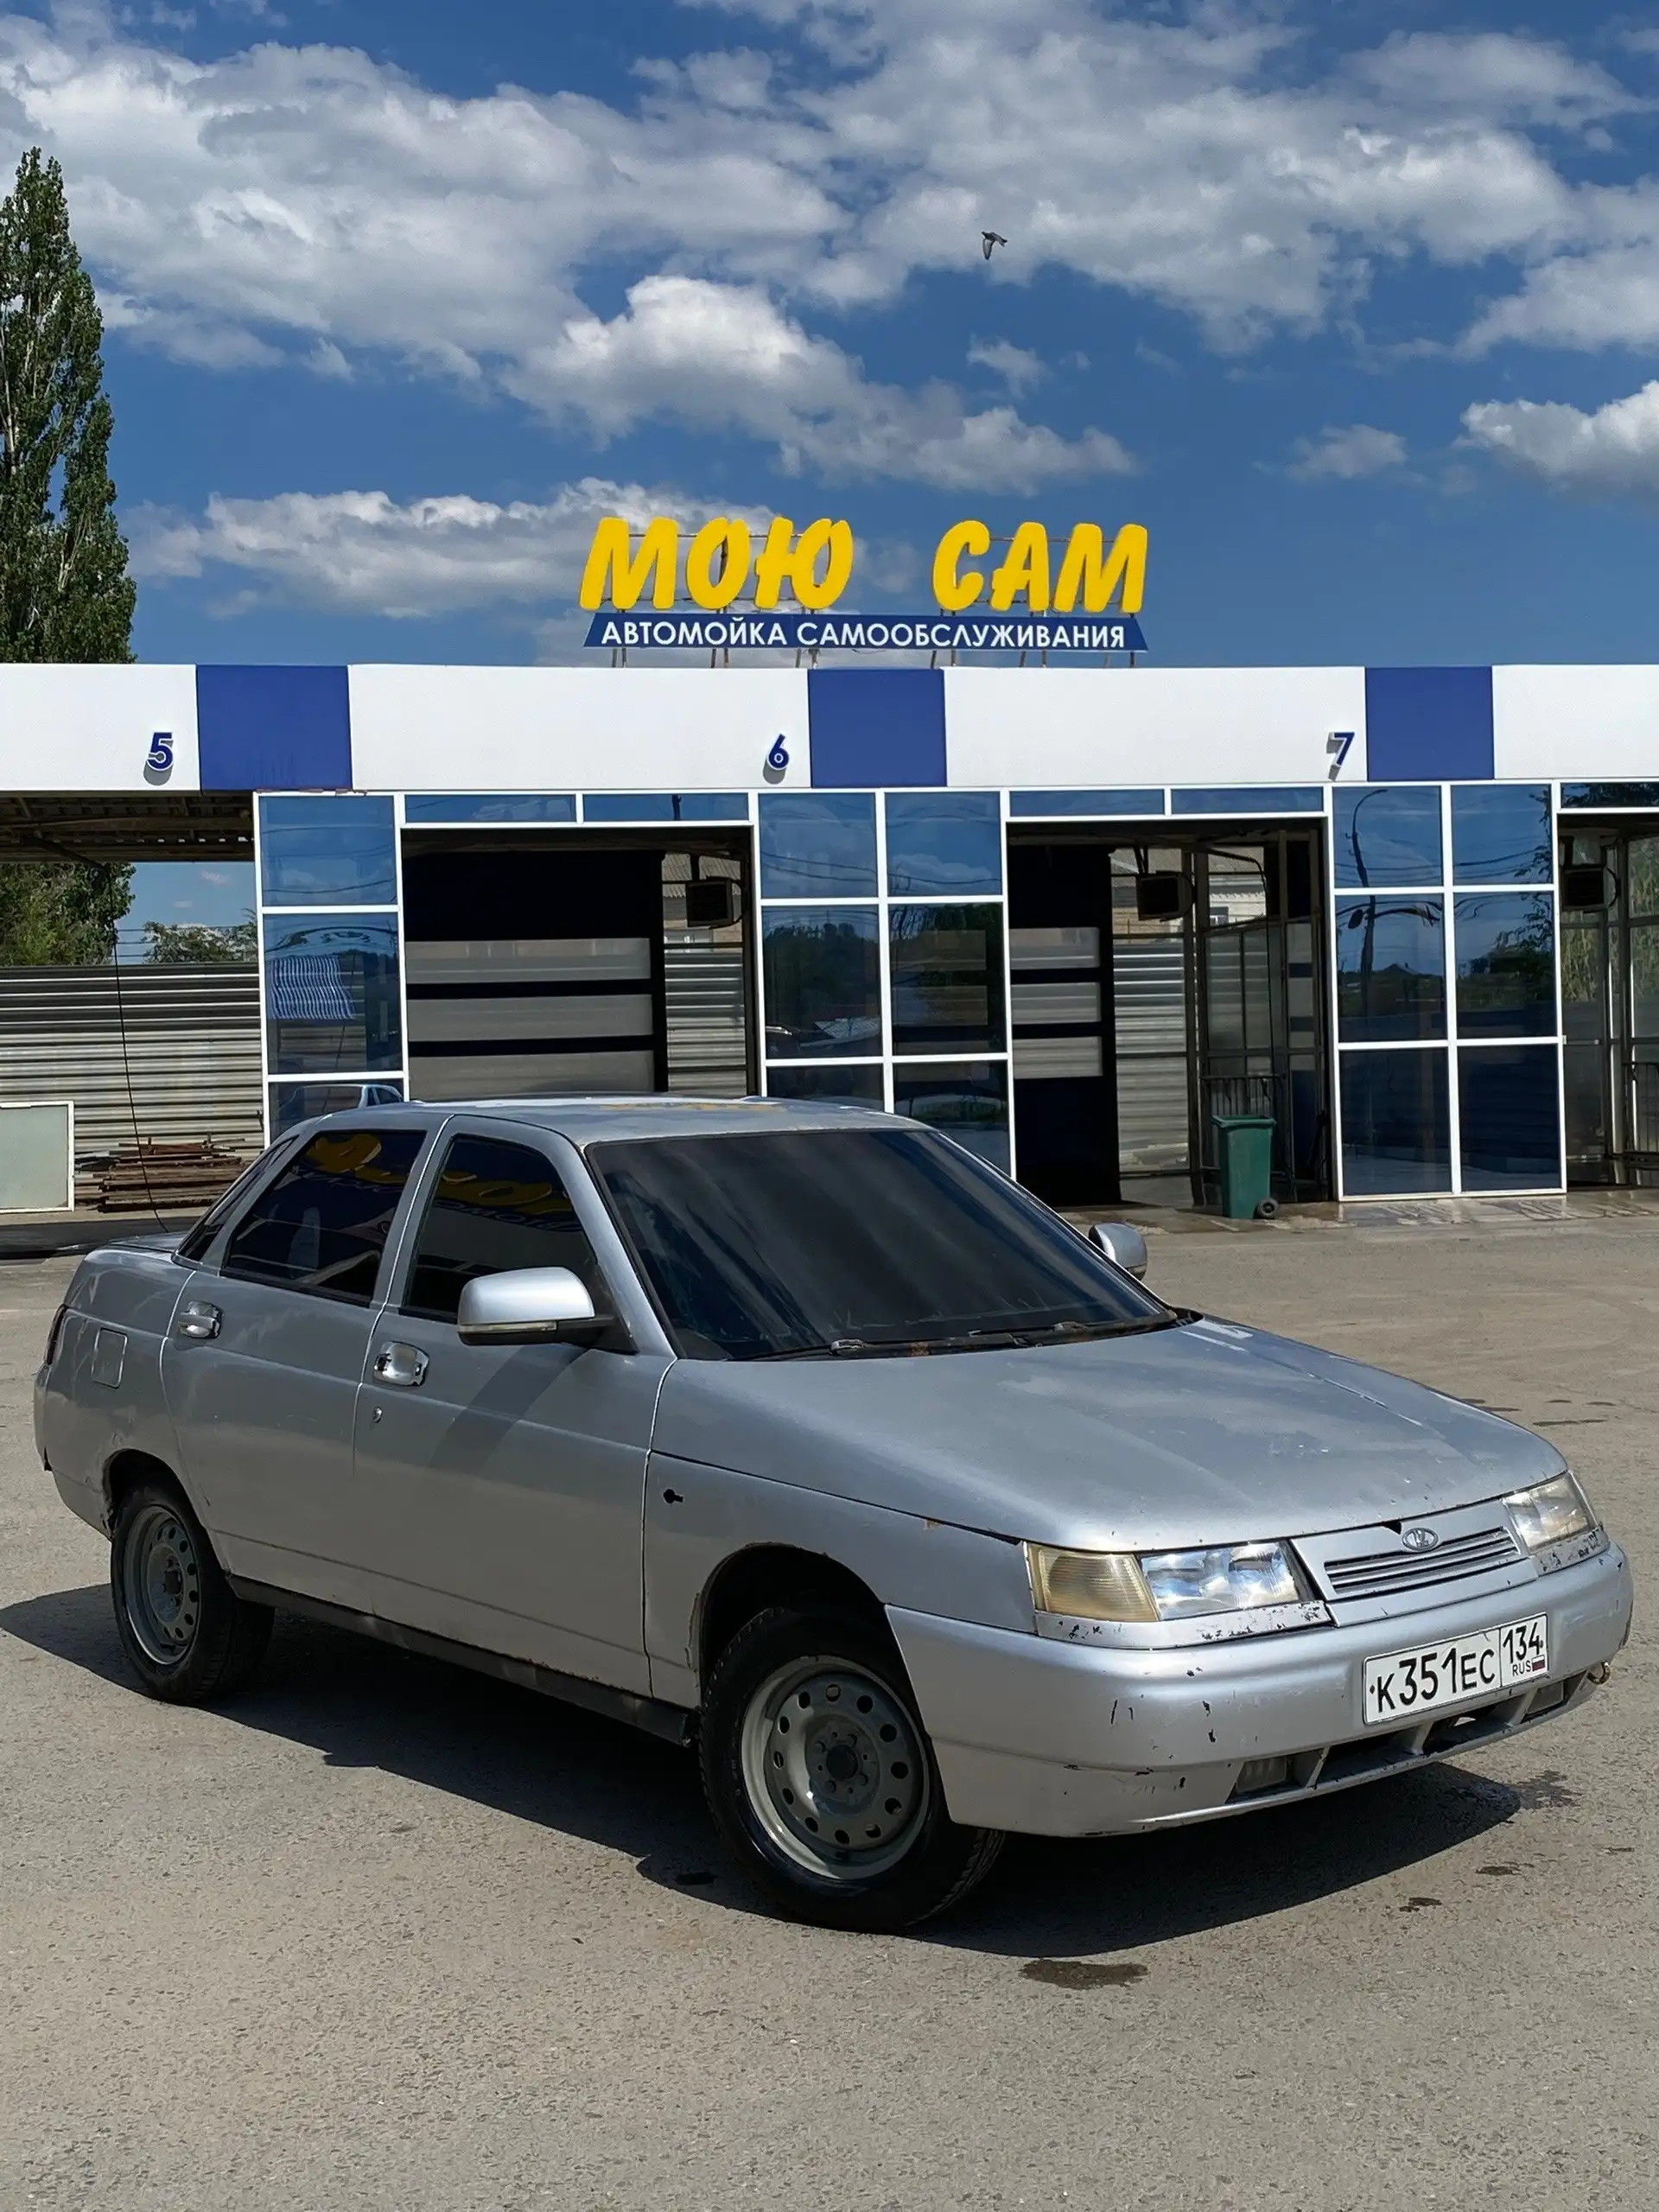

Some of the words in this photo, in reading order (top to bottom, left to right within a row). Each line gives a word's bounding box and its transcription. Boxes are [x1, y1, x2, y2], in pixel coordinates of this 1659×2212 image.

[579, 517, 854, 611] МОЮ
[932, 519, 1148, 613] САМ
[601, 616, 788, 645] АВТОМОЙКА
[796, 621, 1125, 648] САМООБСЛУЖИВАНИЯ
[146, 731, 174, 771] 5
[767, 733, 790, 770] 6
[1330, 731, 1355, 767] 7
[1376, 1647, 1496, 1713] К351ЕС
[1502, 1621, 1541, 1664] 134
[1511, 1659, 1532, 1677] RUS
